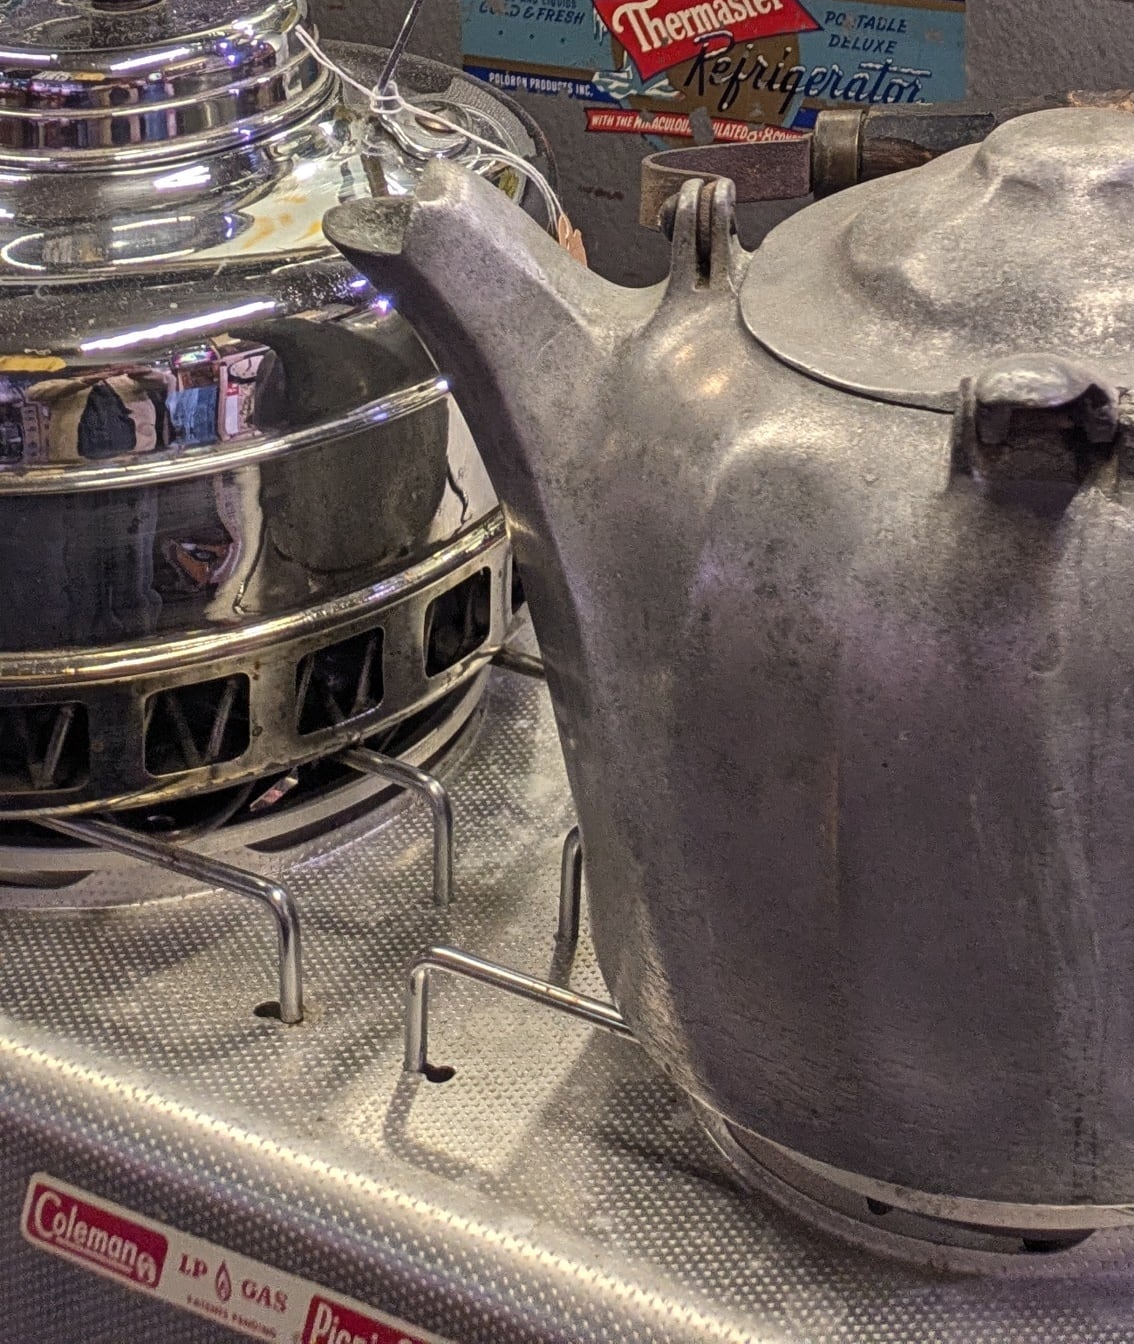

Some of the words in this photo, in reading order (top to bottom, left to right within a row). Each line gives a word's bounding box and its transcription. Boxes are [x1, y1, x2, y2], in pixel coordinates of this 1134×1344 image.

[523, 6, 535, 19] &
[535, 7, 585, 25] FRESH
[824, 11, 908, 34] POTABLE
[828, 34, 899, 55] DELUXE
[683, 29, 933, 114] Refrigerator
[575, 82, 594, 97] INC.
[591, 115, 614, 127] WITH
[615, 116, 633, 127] THE
[35, 1191, 138, 1267] Coleman
[178, 1253, 208, 1278] LP
[241, 1279, 288, 1313] GAS
